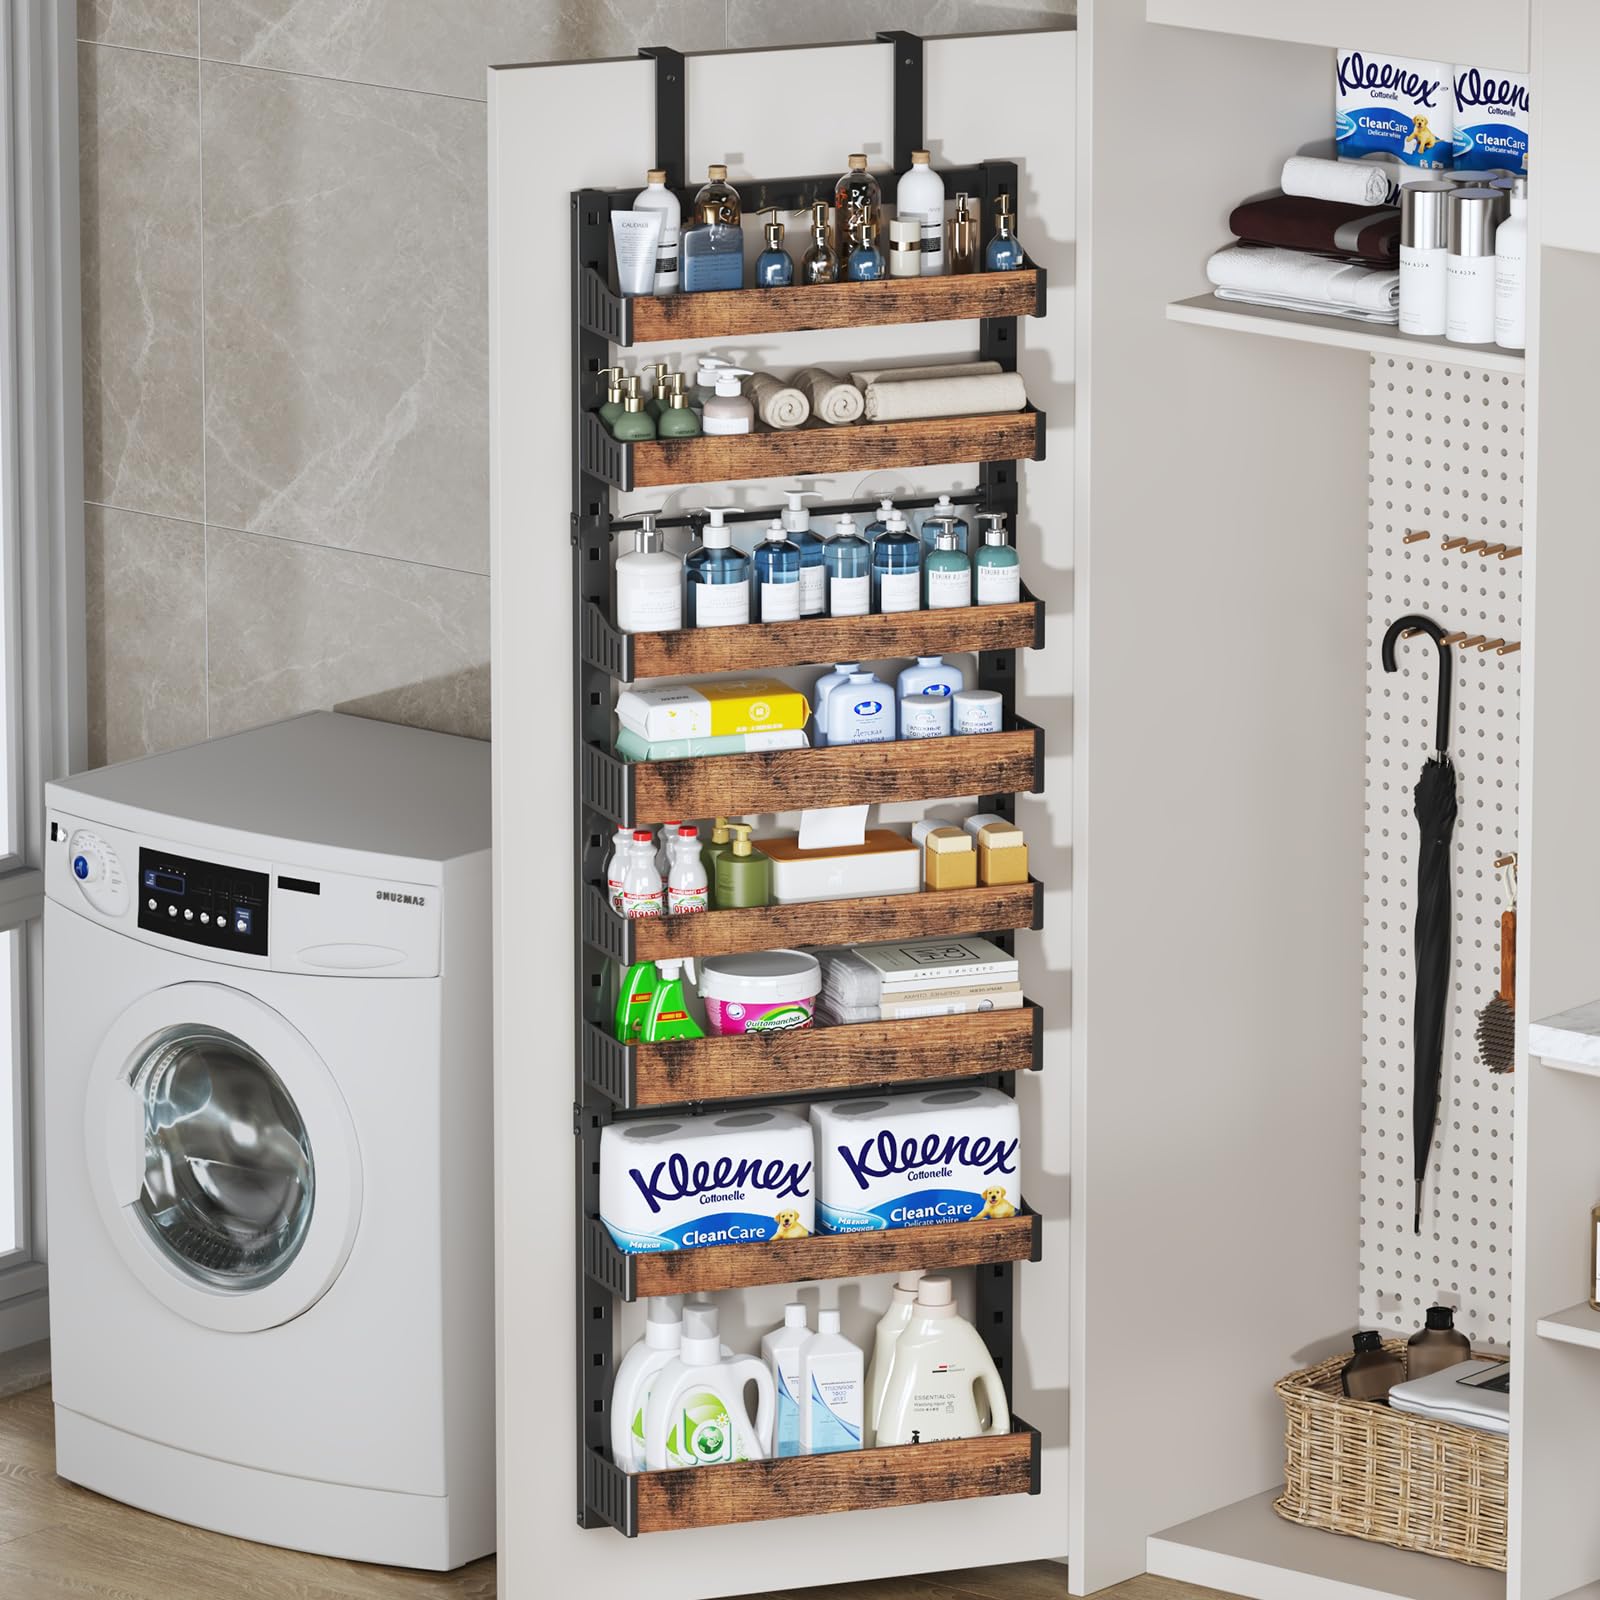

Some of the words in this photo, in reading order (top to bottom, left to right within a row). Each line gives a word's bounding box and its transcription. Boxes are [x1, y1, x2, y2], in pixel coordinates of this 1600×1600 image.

[1336, 52, 1440, 108] Kleenex
[1370, 89, 1399, 101] Cottonelle
[1487, 105, 1517, 117] Cottonelle
[1358, 116, 1408, 133] CleanCare
[1475, 133, 1526, 150] CleanCare
[745, 1014, 801, 1028] Quitamanchas
[837, 1130, 1018, 1190] Kleenex
[628, 1153, 812, 1213] Kleenex
[907, 1167, 953, 1182] Cottonelle
[699, 1190, 745, 1205] Cottonelle
[890, 1202, 973, 1222] CleanCare
[681, 1225, 766, 1246] CleanCare
